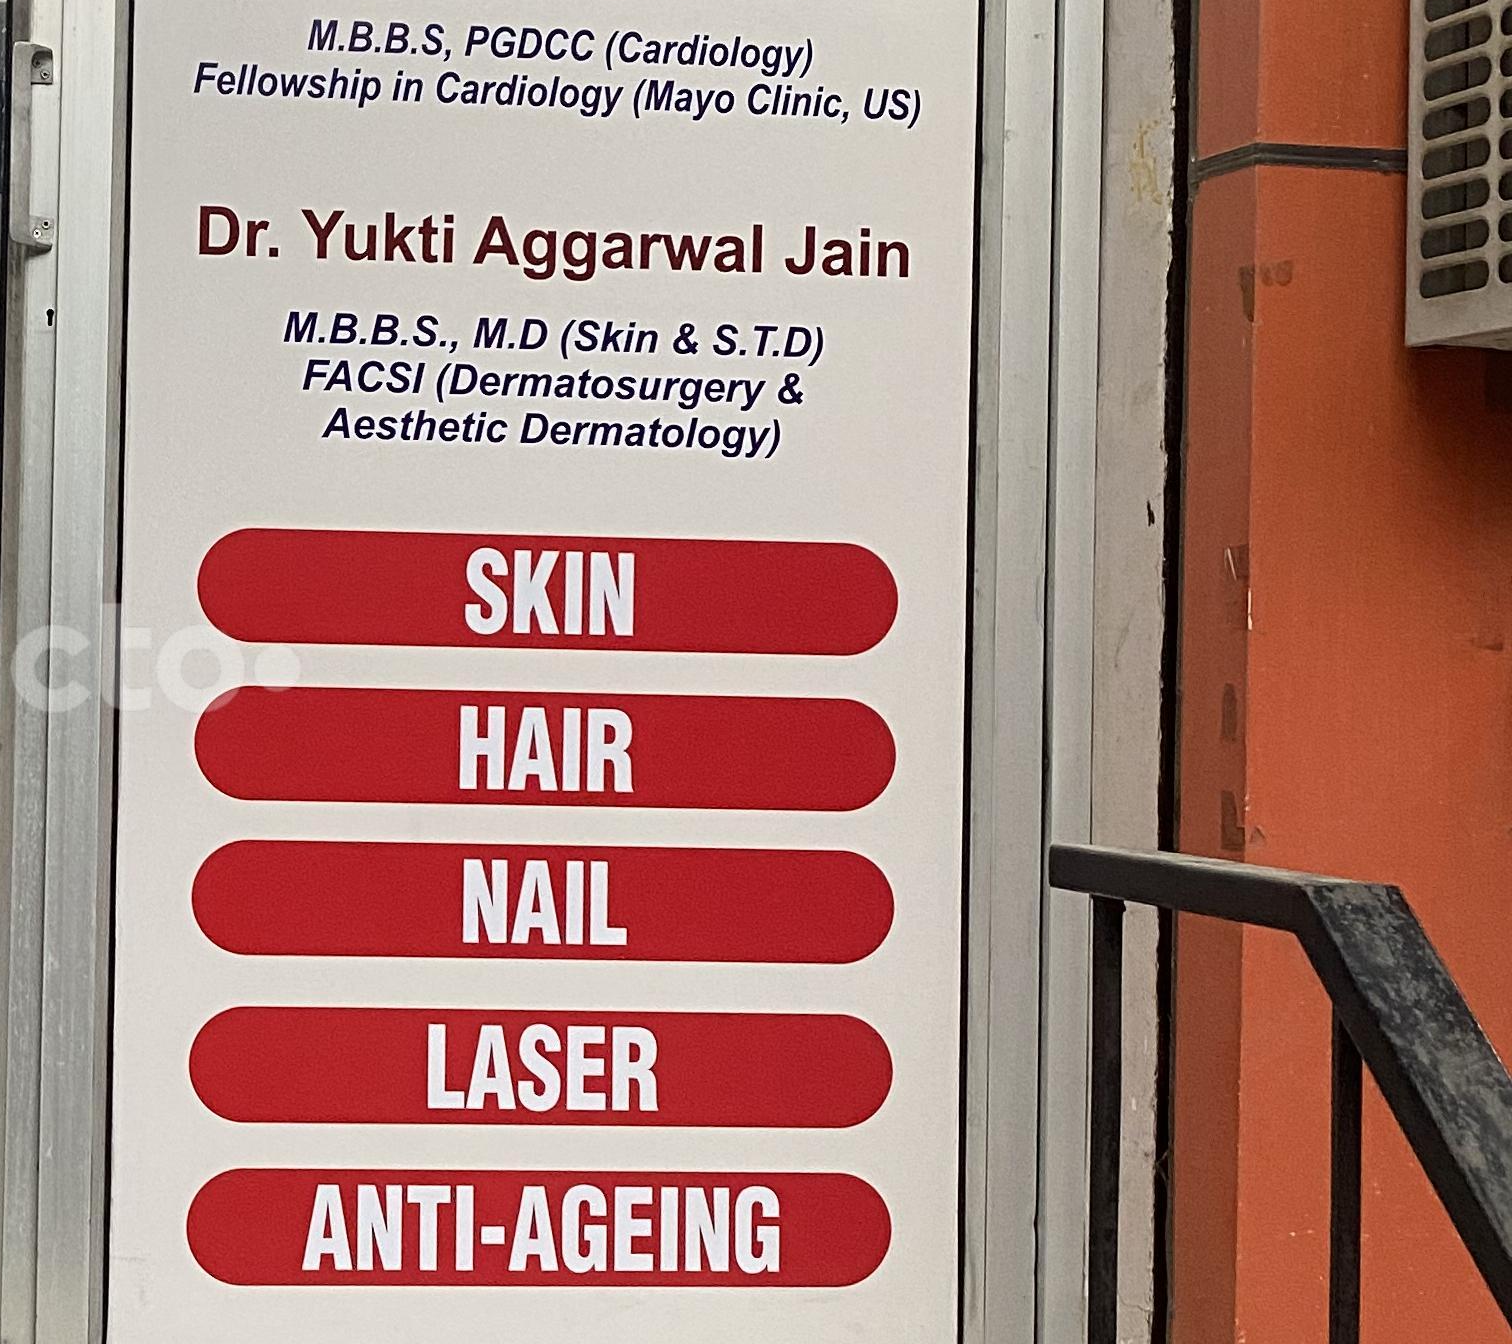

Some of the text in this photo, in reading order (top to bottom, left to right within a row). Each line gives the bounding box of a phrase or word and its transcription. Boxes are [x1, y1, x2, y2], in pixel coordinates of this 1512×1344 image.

[308, 19, 814, 79] M.B.B.S, PGDCC (Cardiology)
[193, 62, 922, 130] Fellowship in Cardiology (Mayo Clinic, US)
[198, 205, 910, 282] Dr. Yukti Aggarwal Jain
[283, 311, 824, 366] M.B.B.S., M.D (Skin & S.T.D)
[302, 359, 804, 411] FACSI (Dermatosurgery &
[321, 407, 781, 459] Aesthetic Dermatology)
[464, 547, 636, 637] SKIN
[458, 705, 635, 793] HAIR
[462, 858, 628, 946] NAIL
[427, 1023, 660, 1112] LASER
[301, 1183, 781, 1275] ANTI-AGEING
